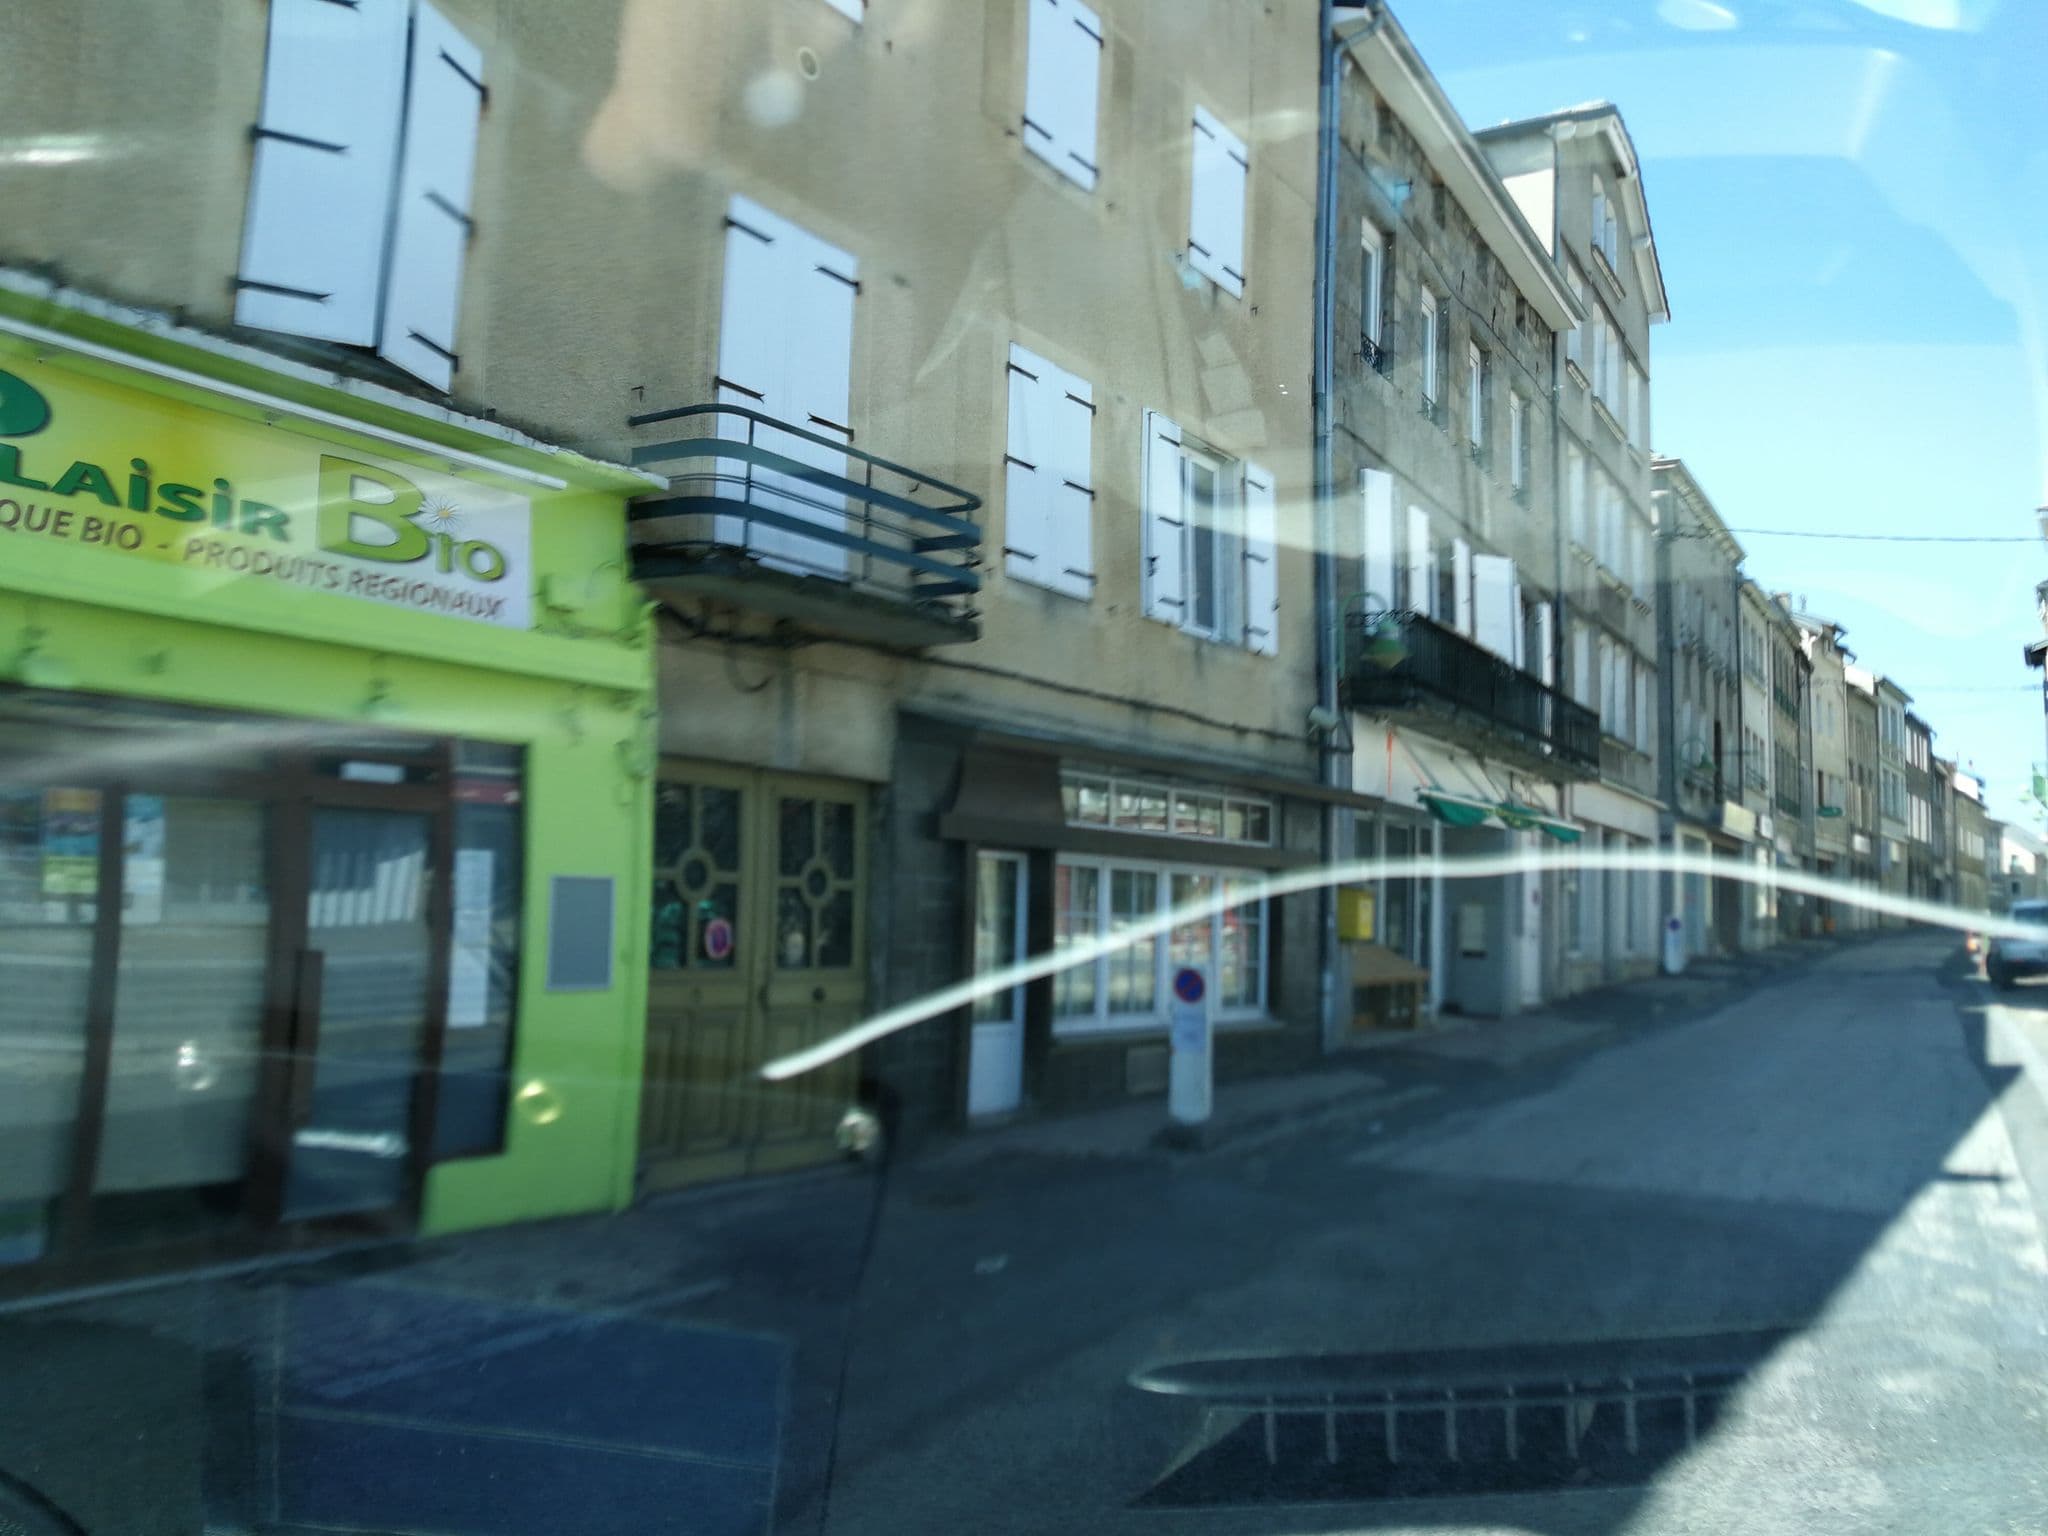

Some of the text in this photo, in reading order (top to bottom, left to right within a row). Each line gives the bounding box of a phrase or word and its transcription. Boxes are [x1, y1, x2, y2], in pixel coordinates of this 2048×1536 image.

[80, 516, 143, 550] BIO
[182, 536, 341, 590] PRODUITS
[346, 568, 507, 620] REGIONAUX
